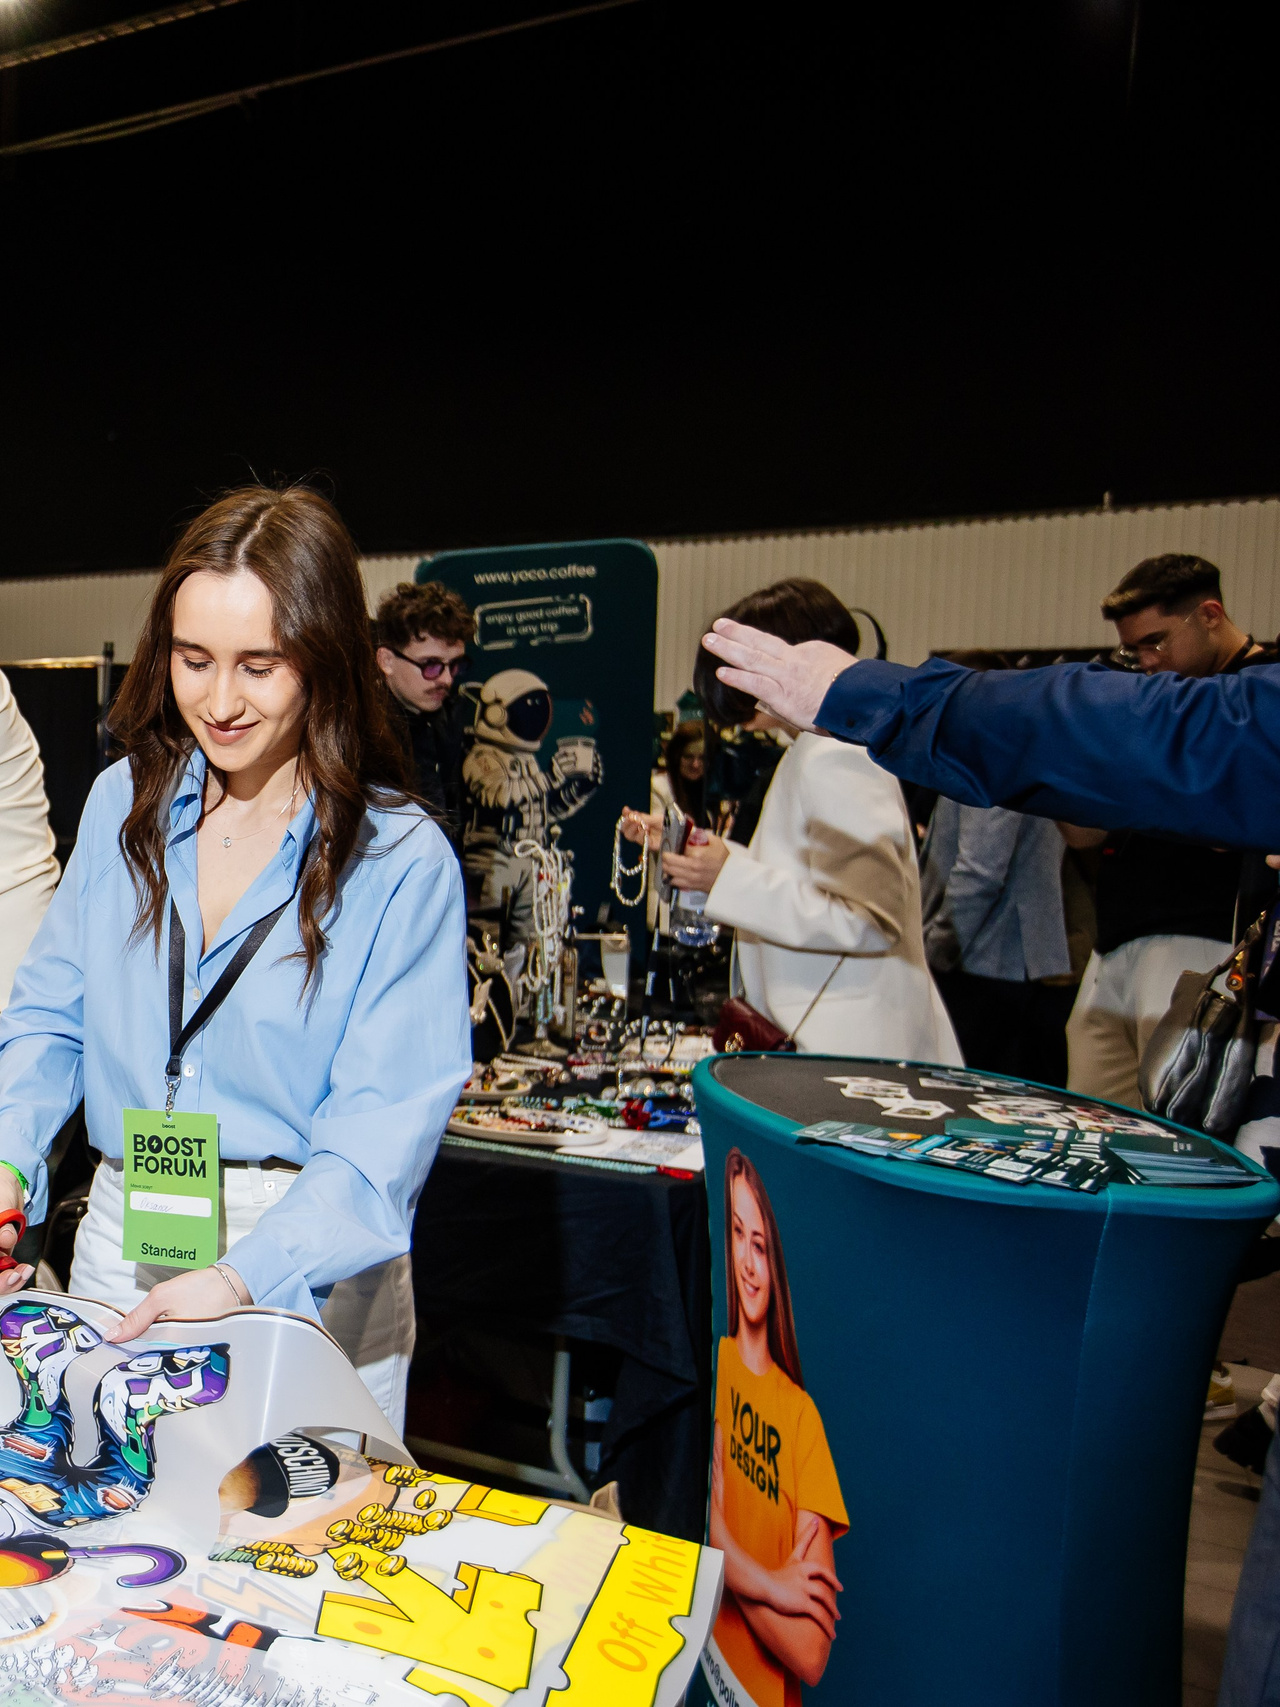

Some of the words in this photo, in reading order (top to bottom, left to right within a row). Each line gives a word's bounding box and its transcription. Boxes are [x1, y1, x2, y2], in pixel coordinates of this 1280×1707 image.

[474, 563, 597, 585] www.yoco.coffee
[515, 609, 543, 623] good
[545, 605, 580, 618] coffee
[506, 625, 517, 636] in
[518, 624, 538, 635] any
[540, 621, 559, 634] trip
[133, 1134, 207, 1157] BOOST
[133, 1155, 207, 1178] FORUM
[141, 1242, 197, 1261] Standard
[730, 1386, 781, 1478] YOUR
[730, 1433, 779, 1506] DESIGN
[597, 1612, 665, 1673] Off
